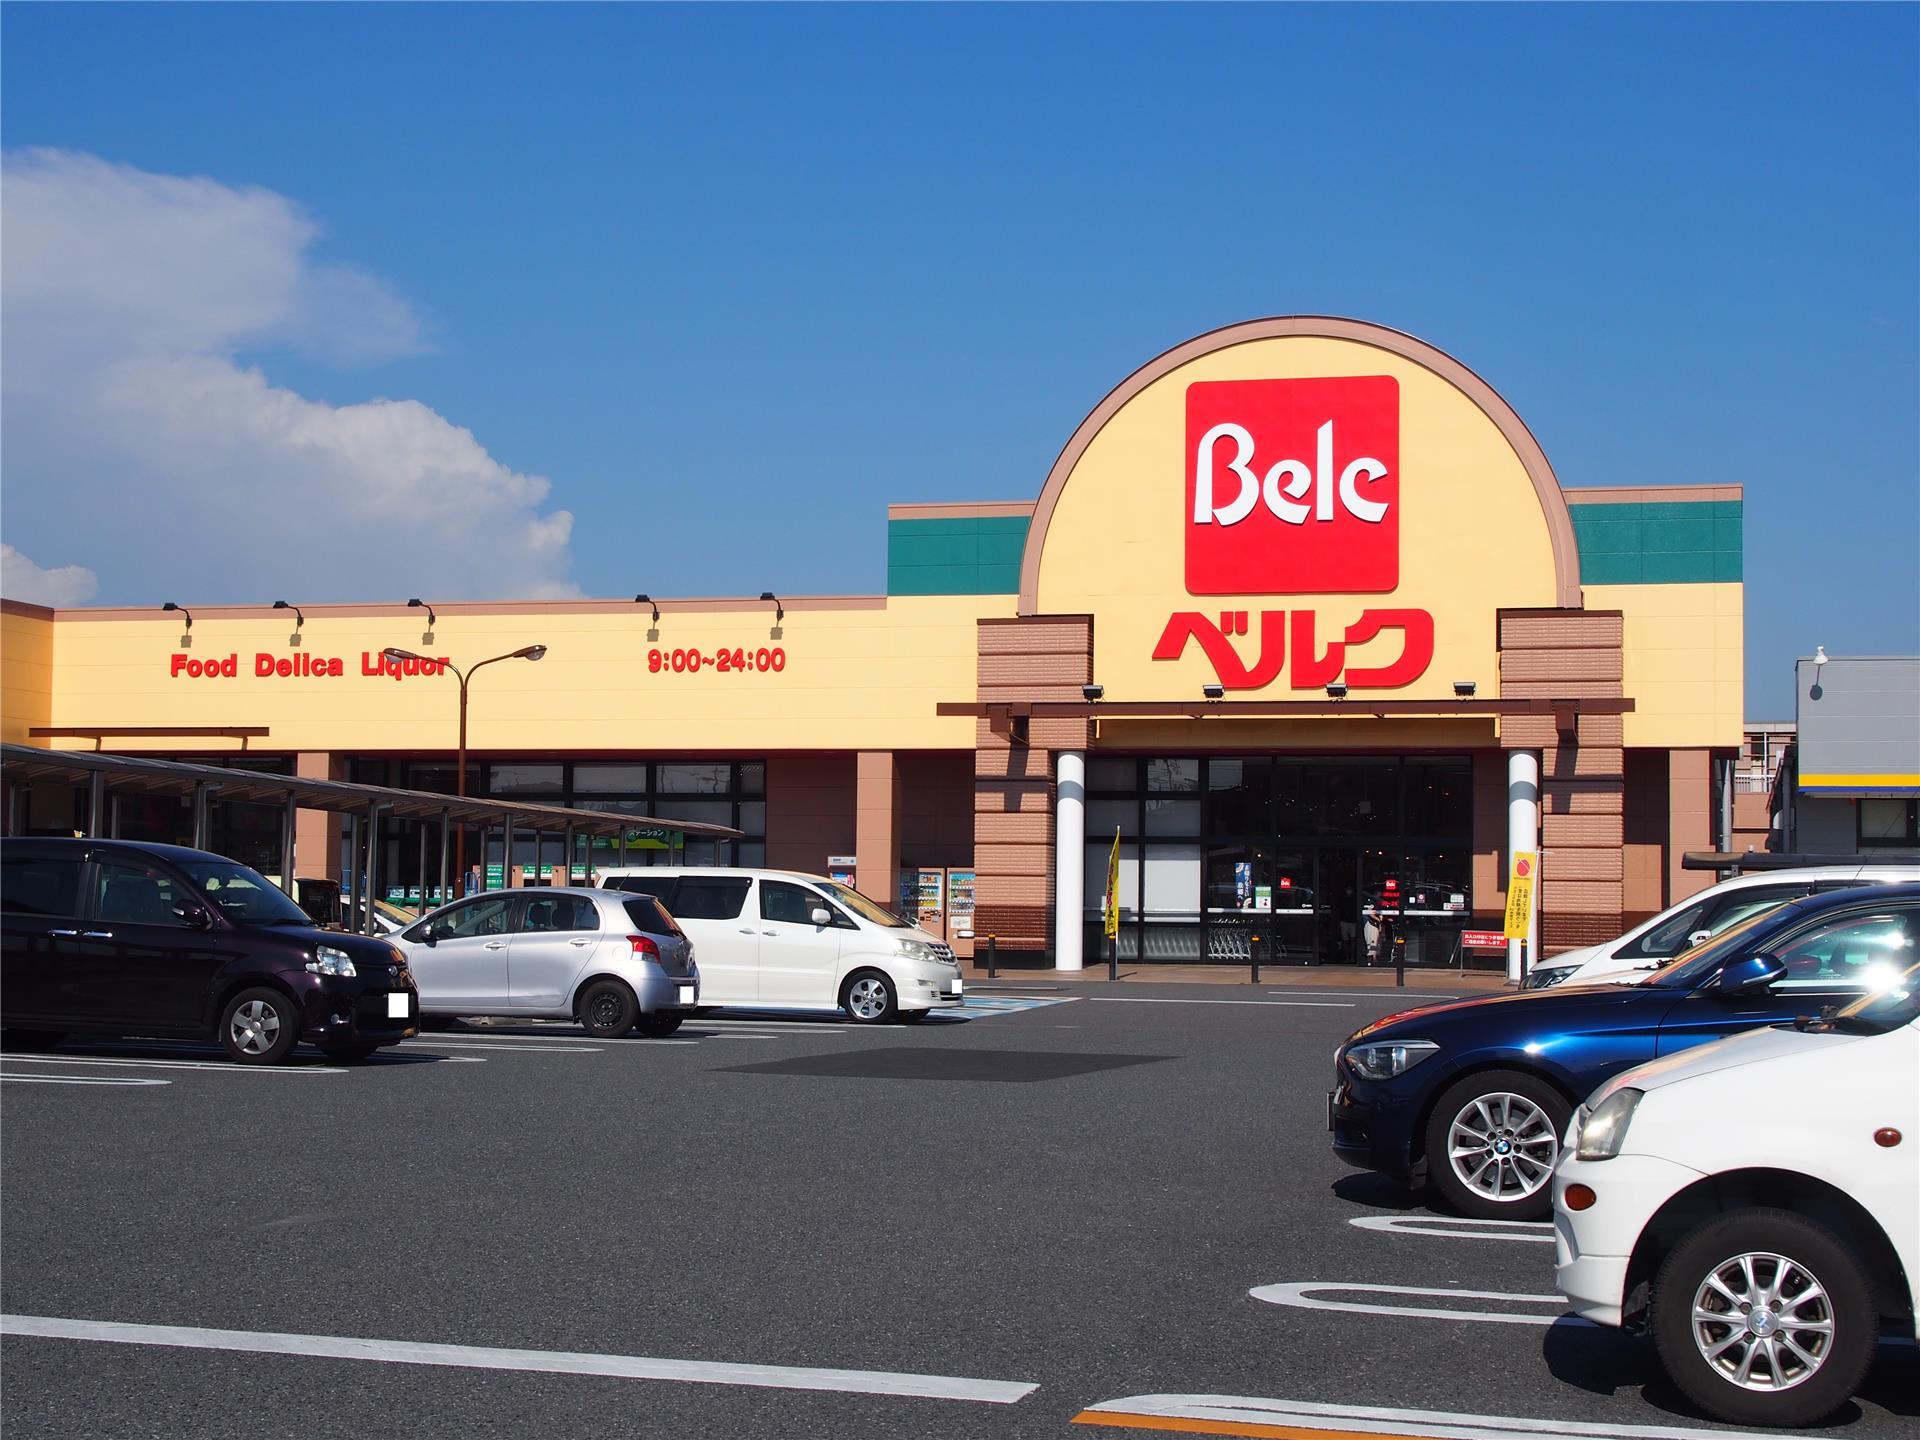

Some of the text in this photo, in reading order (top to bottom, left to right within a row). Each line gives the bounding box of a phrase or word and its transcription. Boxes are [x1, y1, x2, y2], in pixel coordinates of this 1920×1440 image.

[1193, 418, 1390, 527] Belc
[171, 651, 450, 681] Food Delica Liquor
[647, 647, 786, 673] 9:00~24:00
[1151, 608, 1435, 690] ベルク
